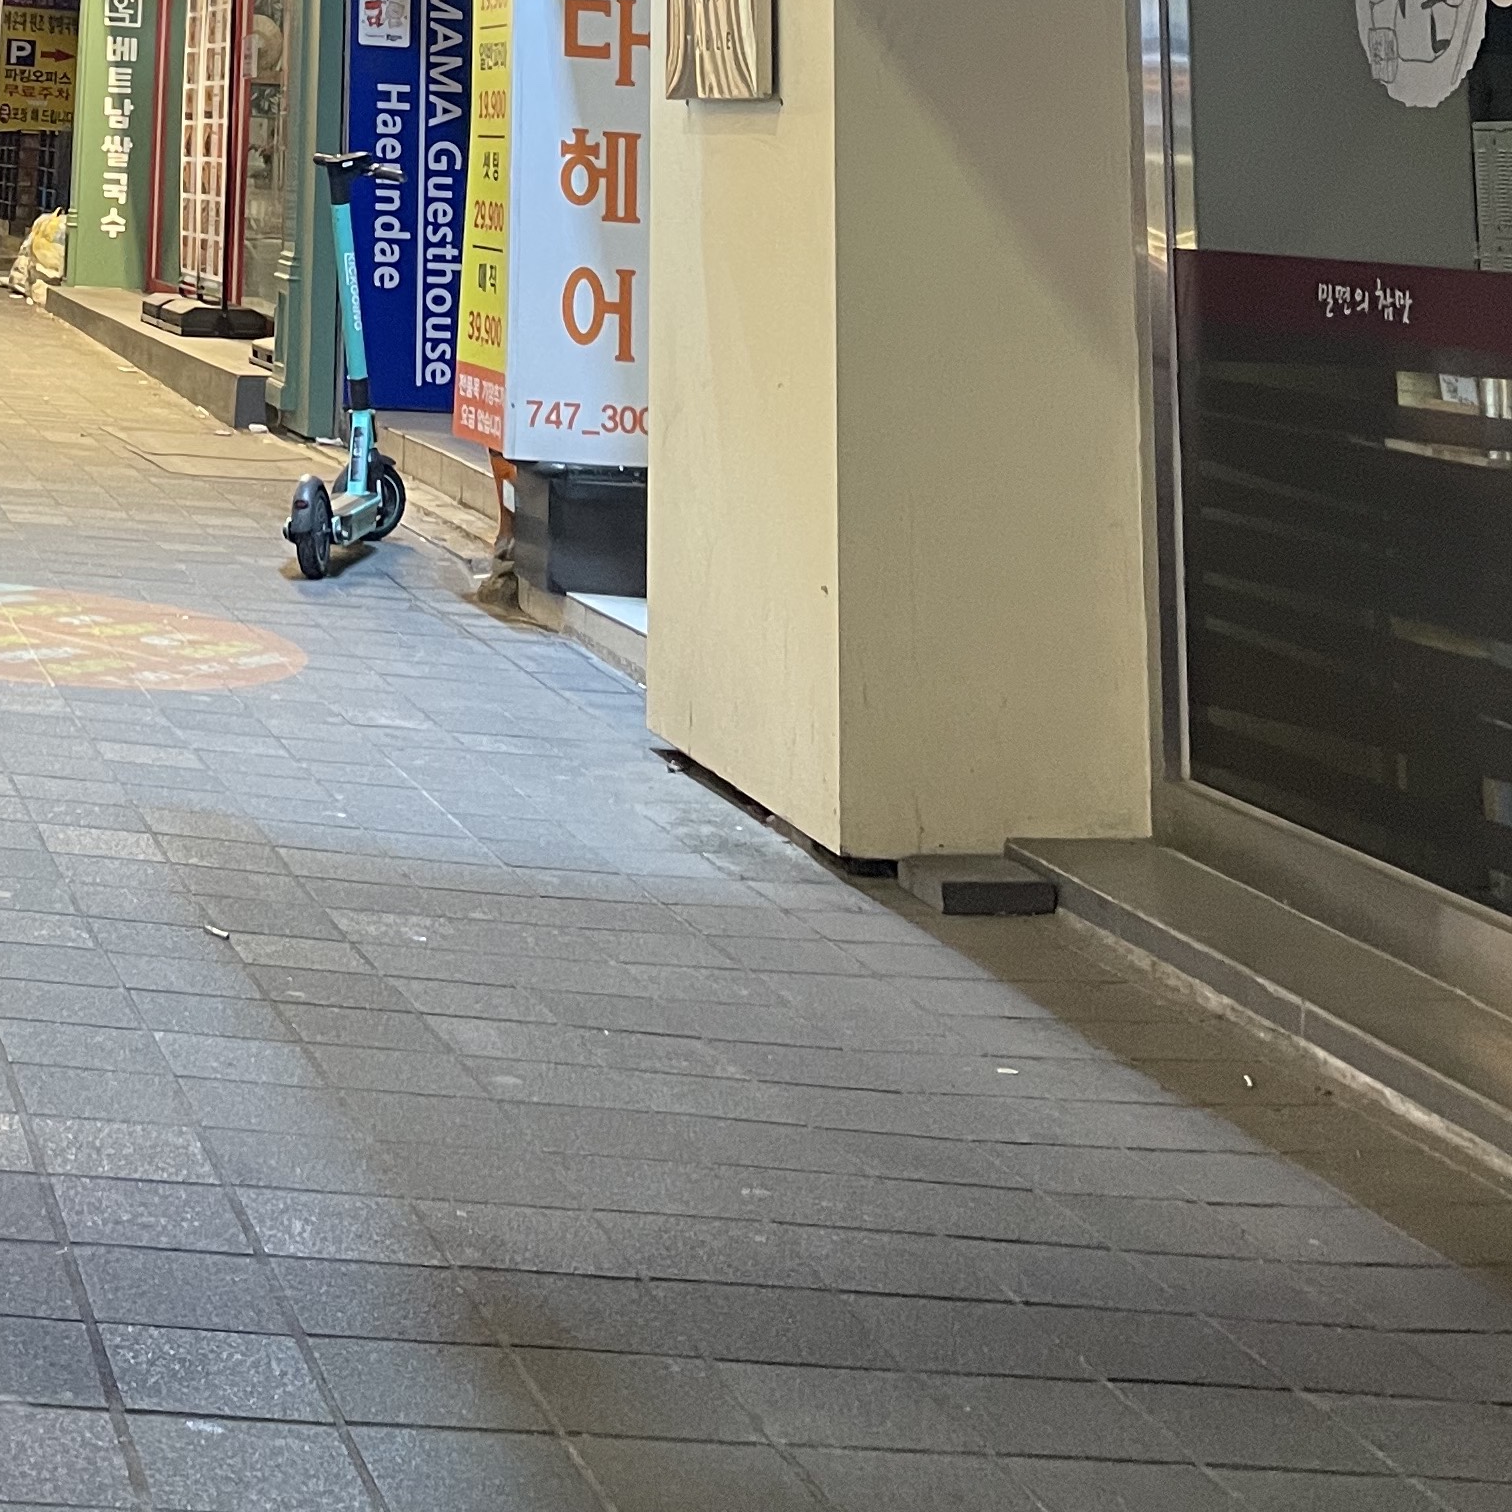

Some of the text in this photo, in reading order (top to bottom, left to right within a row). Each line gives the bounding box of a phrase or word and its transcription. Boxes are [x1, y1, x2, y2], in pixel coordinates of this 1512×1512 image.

[9, 41, 32, 64] P
[4, 68, 72, 86] 파킹오피스
[478, 90, 506, 119] 19,900
[101, 36, 138, 239] 베트남쌀국수
[474, 200, 503, 232] 29,900
[425, 141, 464, 386] Guesthouse
[1318, 277, 1413, 324] 밀면의 참맛
[468, 310, 502, 347] 39,900
